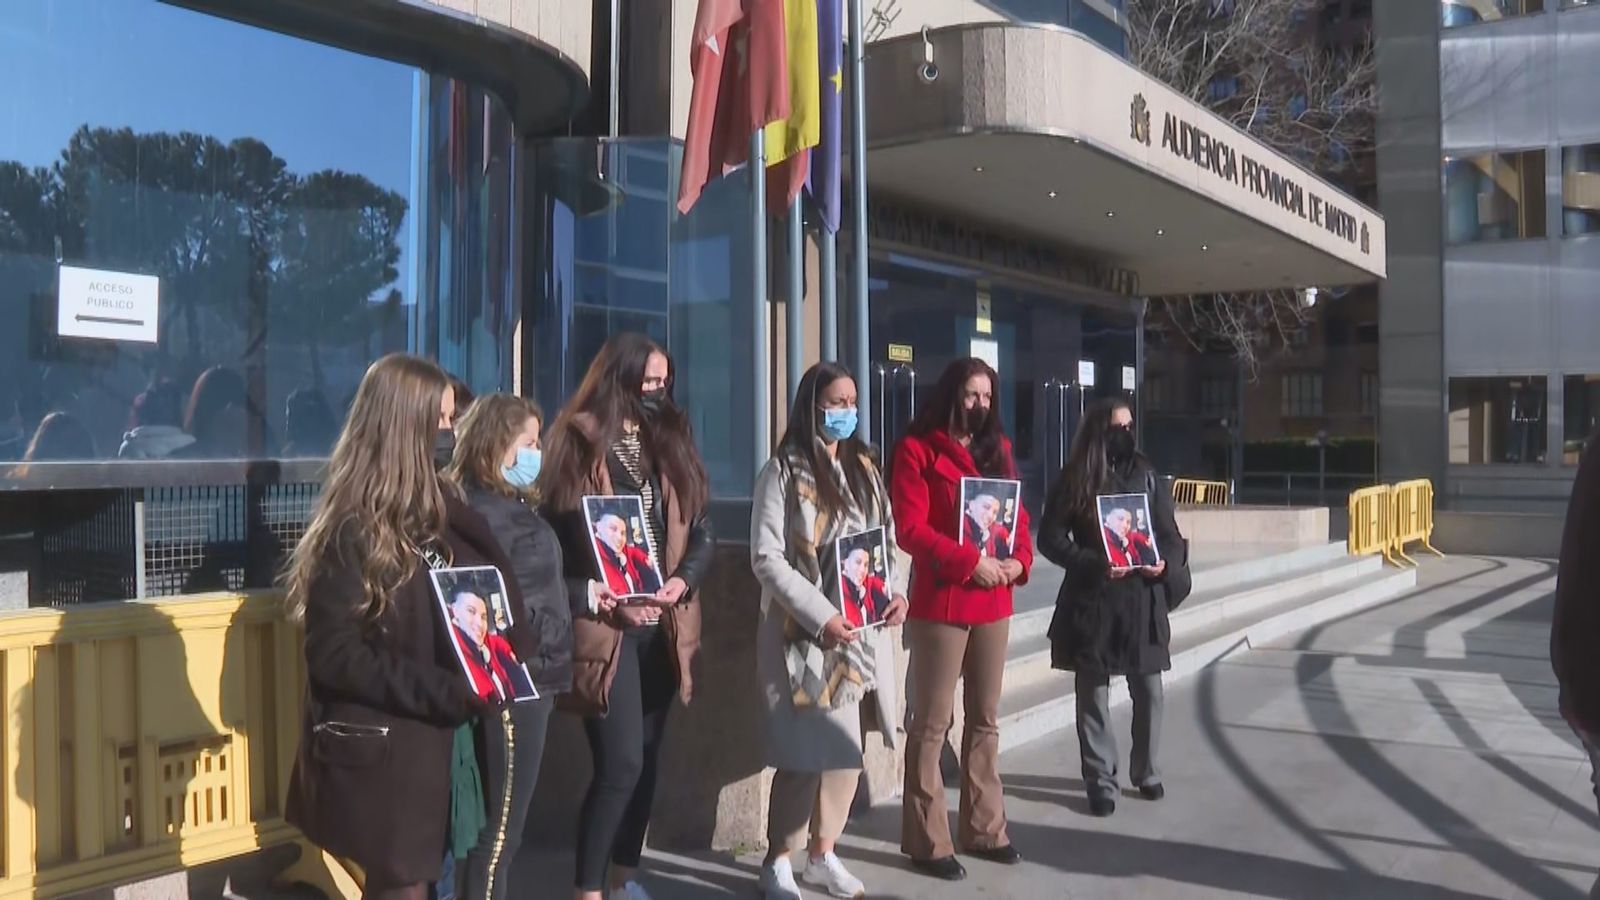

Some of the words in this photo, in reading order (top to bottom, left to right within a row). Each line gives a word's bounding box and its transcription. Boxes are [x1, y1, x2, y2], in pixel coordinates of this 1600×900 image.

[1162, 112, 1238, 185] AUDIENCIA
[1242, 154, 1307, 219] PROVINCIAL
[1309, 192, 1323, 228] DE
[1325, 202, 1357, 244] MADRID
[88, 282, 134, 295] ACCESO
